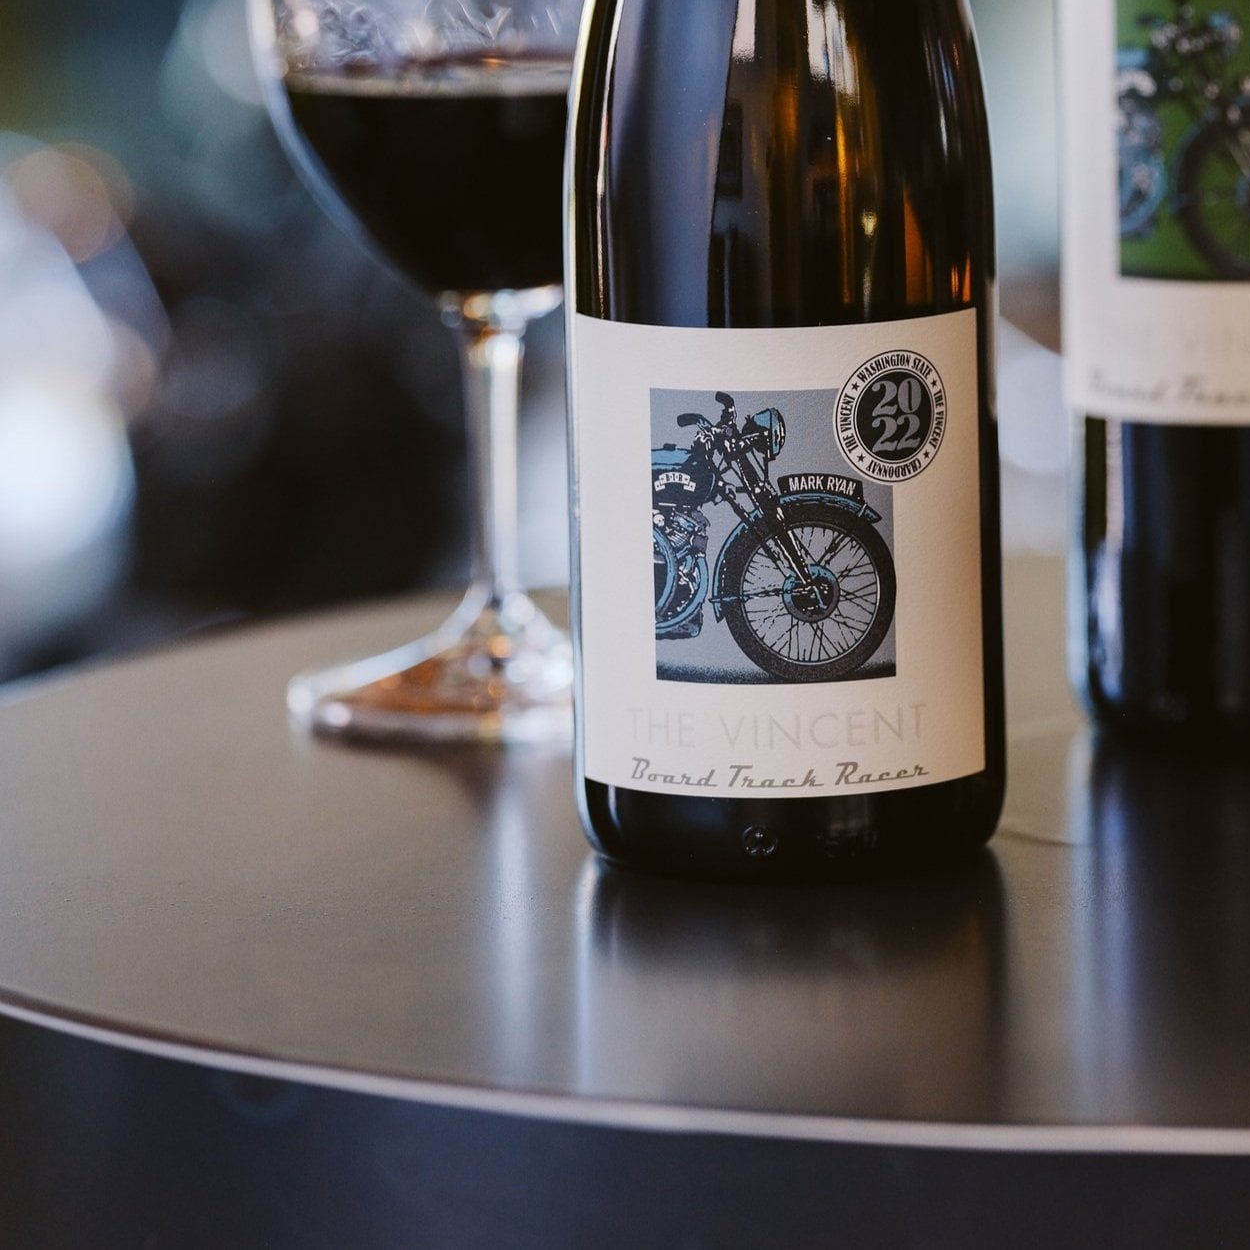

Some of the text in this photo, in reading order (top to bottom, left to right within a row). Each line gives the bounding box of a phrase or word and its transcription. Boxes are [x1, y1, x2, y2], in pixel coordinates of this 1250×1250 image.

[857, 354, 933, 383] WASHINGTON STATE
[871, 377, 922, 417] 20
[839, 393, 858, 454] THE VINCENT
[871, 414, 921, 453] 22
[932, 388, 944, 449] THE VINCENT
[788, 476, 857, 496] MARK RYAN
[865, 459, 922, 478] CHARDONNAY
[626, 703, 928, 750] THE VINCENT
[631, 757, 930, 789] Board Track Racer
